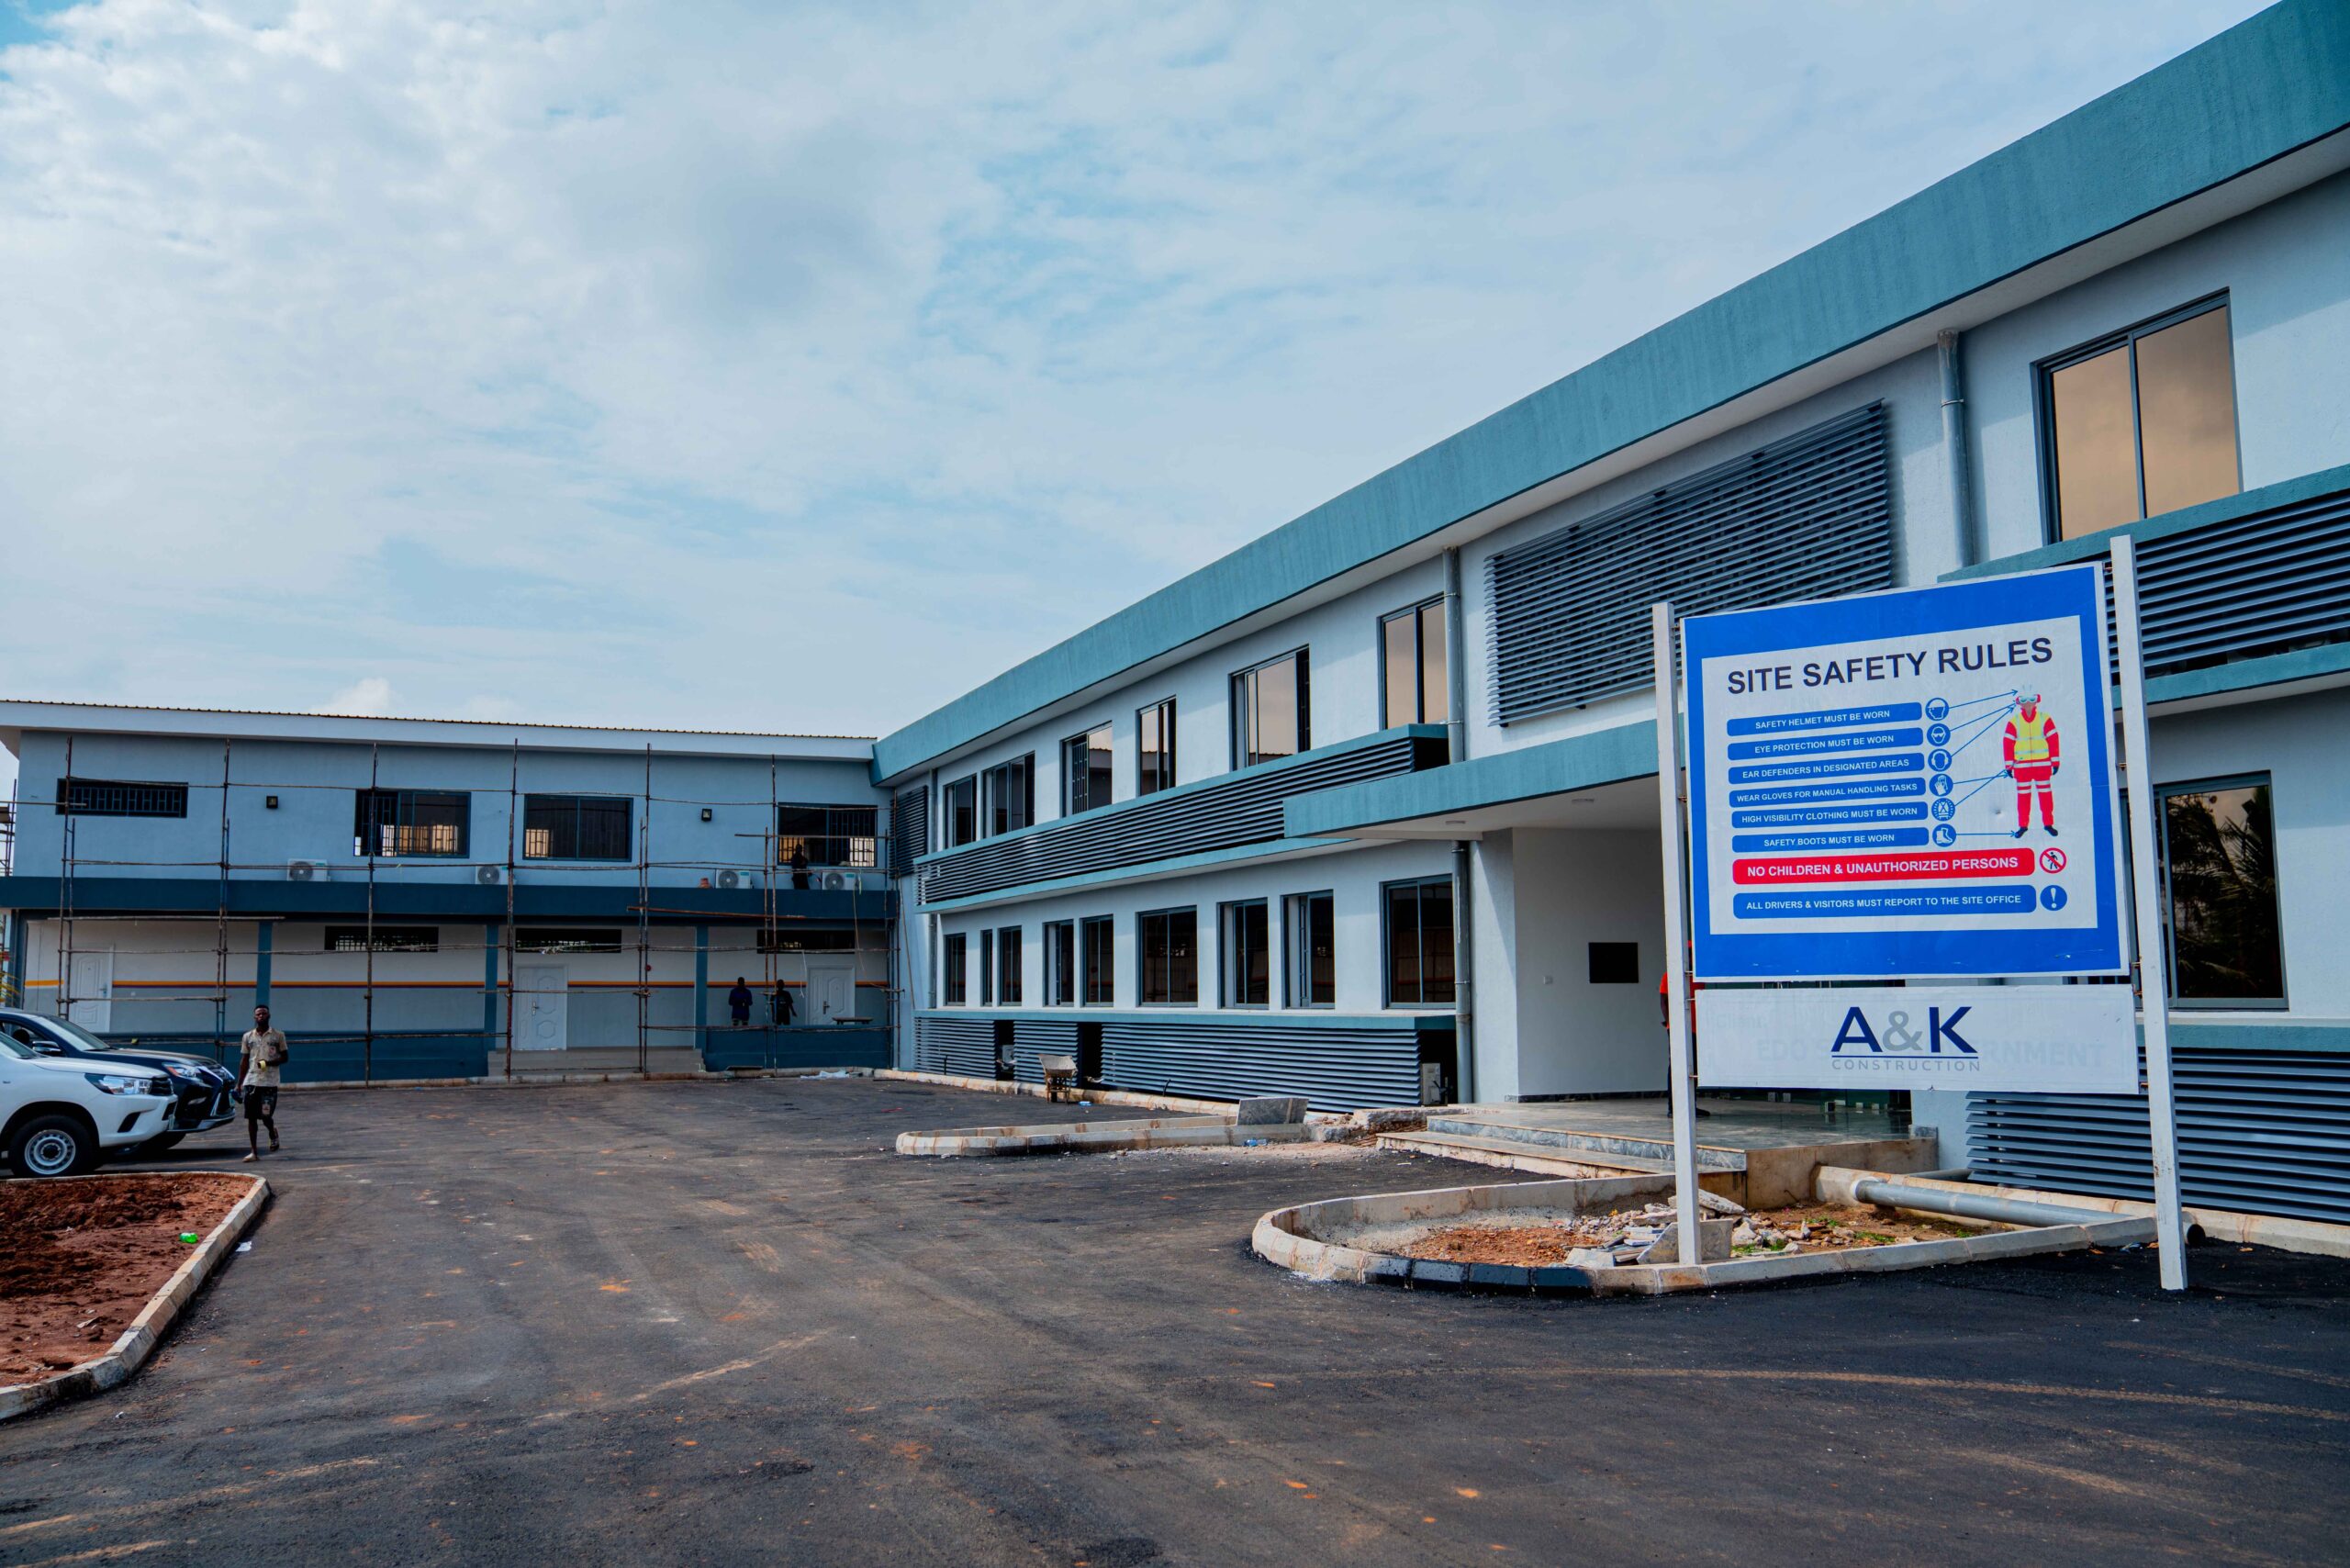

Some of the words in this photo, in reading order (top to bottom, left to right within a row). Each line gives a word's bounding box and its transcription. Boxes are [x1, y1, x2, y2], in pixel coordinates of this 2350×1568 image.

[1728, 666, 1793, 694] SITE
[1803, 651, 1927, 687] SAFETY
[1938, 637, 2053, 673] RULES
[1755, 720, 1786, 729] SAFETY
[1788, 717, 1821, 726] HELMET
[1824, 714, 1847, 723] MUST
[1863, 711, 1890, 719] WORN
[1755, 745, 1771, 754] EYE
[1774, 742, 1825, 752] PROTECTION
[1828, 739, 1851, 747] MUST
[1867, 735, 1894, 744] WORN
[1762, 767, 1810, 777] DEFENDERS
[1824, 762, 1877, 772] DESIGNATED
[1880, 759, 1909, 767] AREAS
[1737, 794, 1760, 802] WEAR
[1762, 792, 1792, 801] GLOVES
[1813, 788, 1846, 797] MANUAL
[1848, 785, 1888, 794] HANDLING
[1891, 783, 1917, 791] TASKS
[1763, 813, 1803, 822] VISIBILITY
[1806, 812, 1849, 820] CLOTHING
[1851, 810, 1874, 818] MUST
[1798, 837, 1826, 846] BOOTS
[1829, 835, 1852, 844] MUST
[1748, 867, 1765, 877] NO
[1769, 864, 1830, 876] CHILDREN
[1834, 864, 1842, 874] &
[1846, 861, 1948, 873] UNAUTHORIZED
[1953, 857, 2019, 870] PERSONS
[1747, 902, 1762, 910] ALL
[1765, 901, 1802, 909] DRIVERS
[1813, 900, 1854, 908] VISITORS
[1857, 899, 1882, 907] MUST
[1885, 898, 1921, 906] REPORT
[1926, 897, 1938, 905] TO
[1941, 897, 1960, 905] THE
[1963, 896, 1983, 904] SITE
[1986, 895, 2021, 903] OFFICE
[1830, 1006, 1978, 1054] A&K
[1831, 1059, 1980, 1071] CONSTRUCTION
